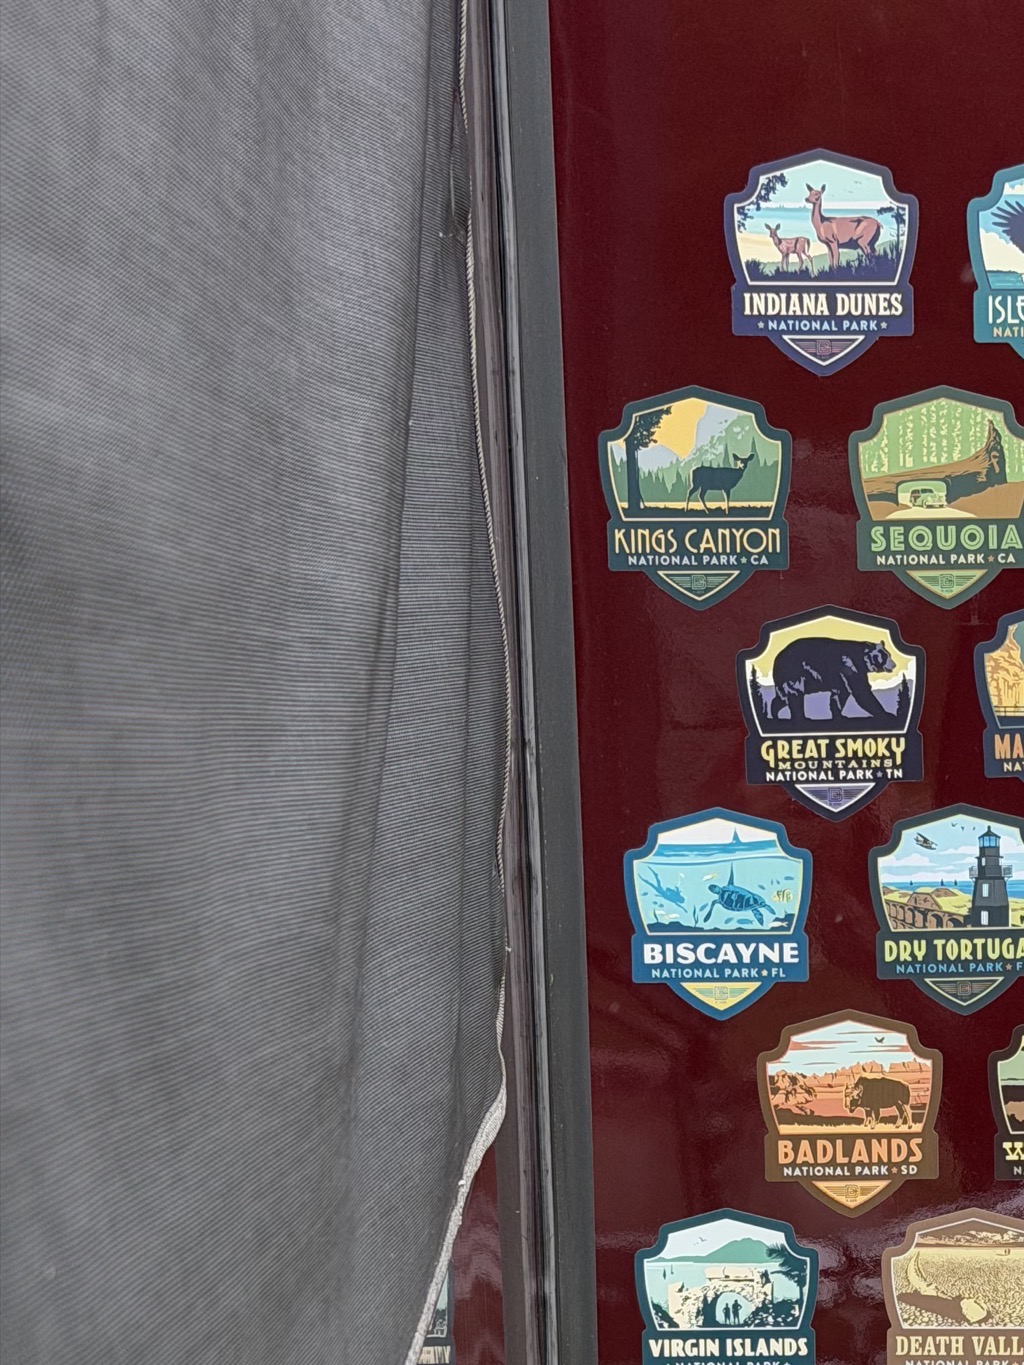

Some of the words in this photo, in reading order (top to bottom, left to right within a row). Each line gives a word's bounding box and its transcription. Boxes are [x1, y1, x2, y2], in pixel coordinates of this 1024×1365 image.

[743, 292, 830, 316] INDIANA
[835, 292, 903, 316] DUNES
[768, 319, 838, 331] NATIONAL
[842, 319, 878, 331] PARK
[614, 528, 678, 554] KINGS
[684, 527, 781, 554] CANYON
[870, 524, 1023, 552] SEQUOIA
[628, 555, 698, 566] NATIONAL
[702, 554, 738, 566] PARK
[750, 554, 769, 565] CA
[760, 738, 833, 770] GREAT
[834, 736, 906, 769] SMOKY
[777, 758, 893, 770] MOUNTAINS
[643, 942, 800, 965] BISCAYNE
[884, 939, 927, 962] DRY
[896, 963, 965, 974] NATIONAL
[969, 961, 1003, 973] PARK
[777, 1137, 923, 1164] BADLANDS
[648, 1338, 720, 1358] VIRGIN
[725, 1337, 808, 1357] ISLANDS
[895, 1335, 965, 1356] DEATH
